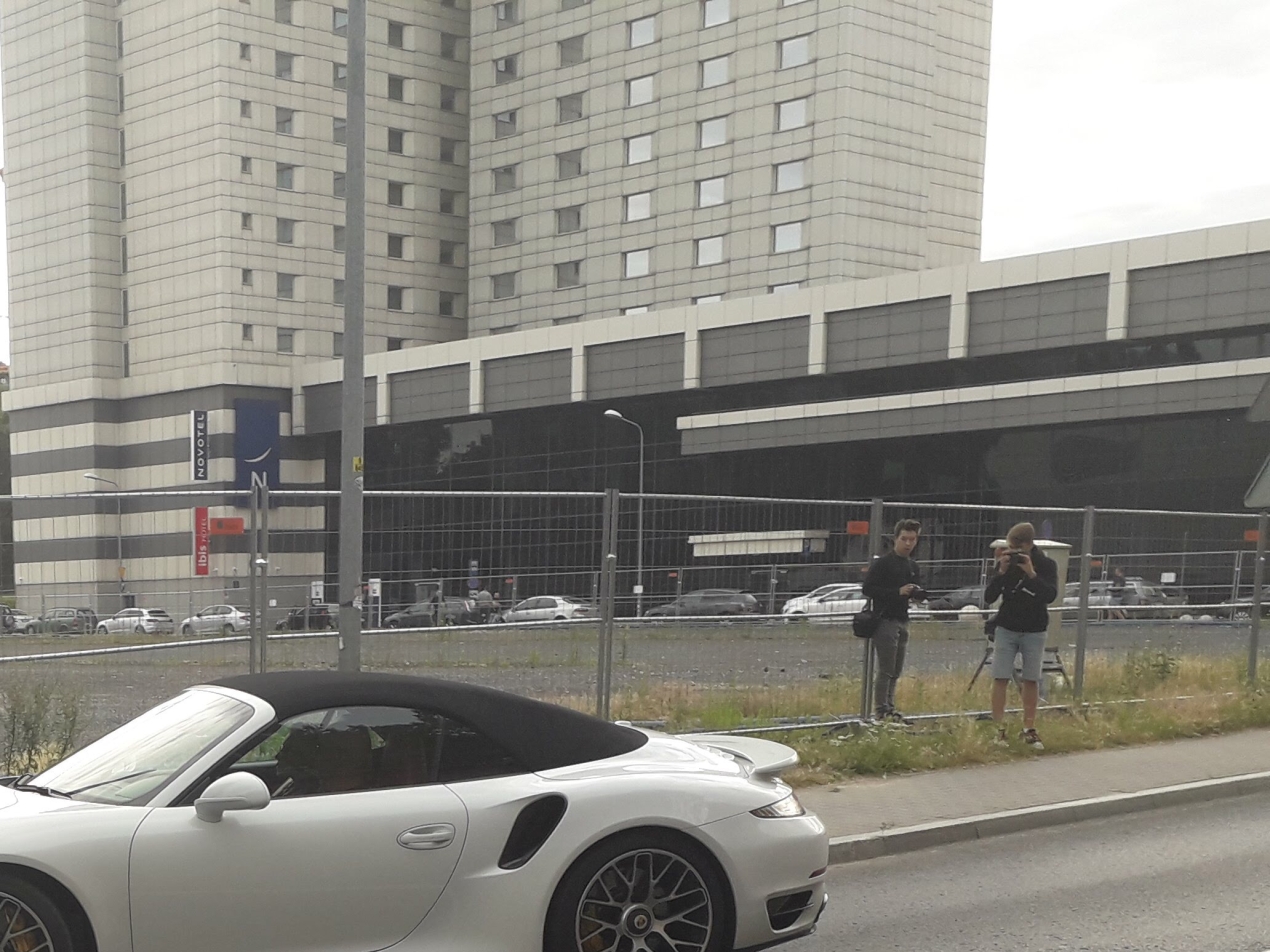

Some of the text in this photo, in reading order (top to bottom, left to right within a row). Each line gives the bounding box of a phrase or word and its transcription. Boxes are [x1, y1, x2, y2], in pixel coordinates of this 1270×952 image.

[197, 414, 205, 477] NOVOTEL
[251, 471, 267, 489] N
[197, 545, 207, 567] ibis
